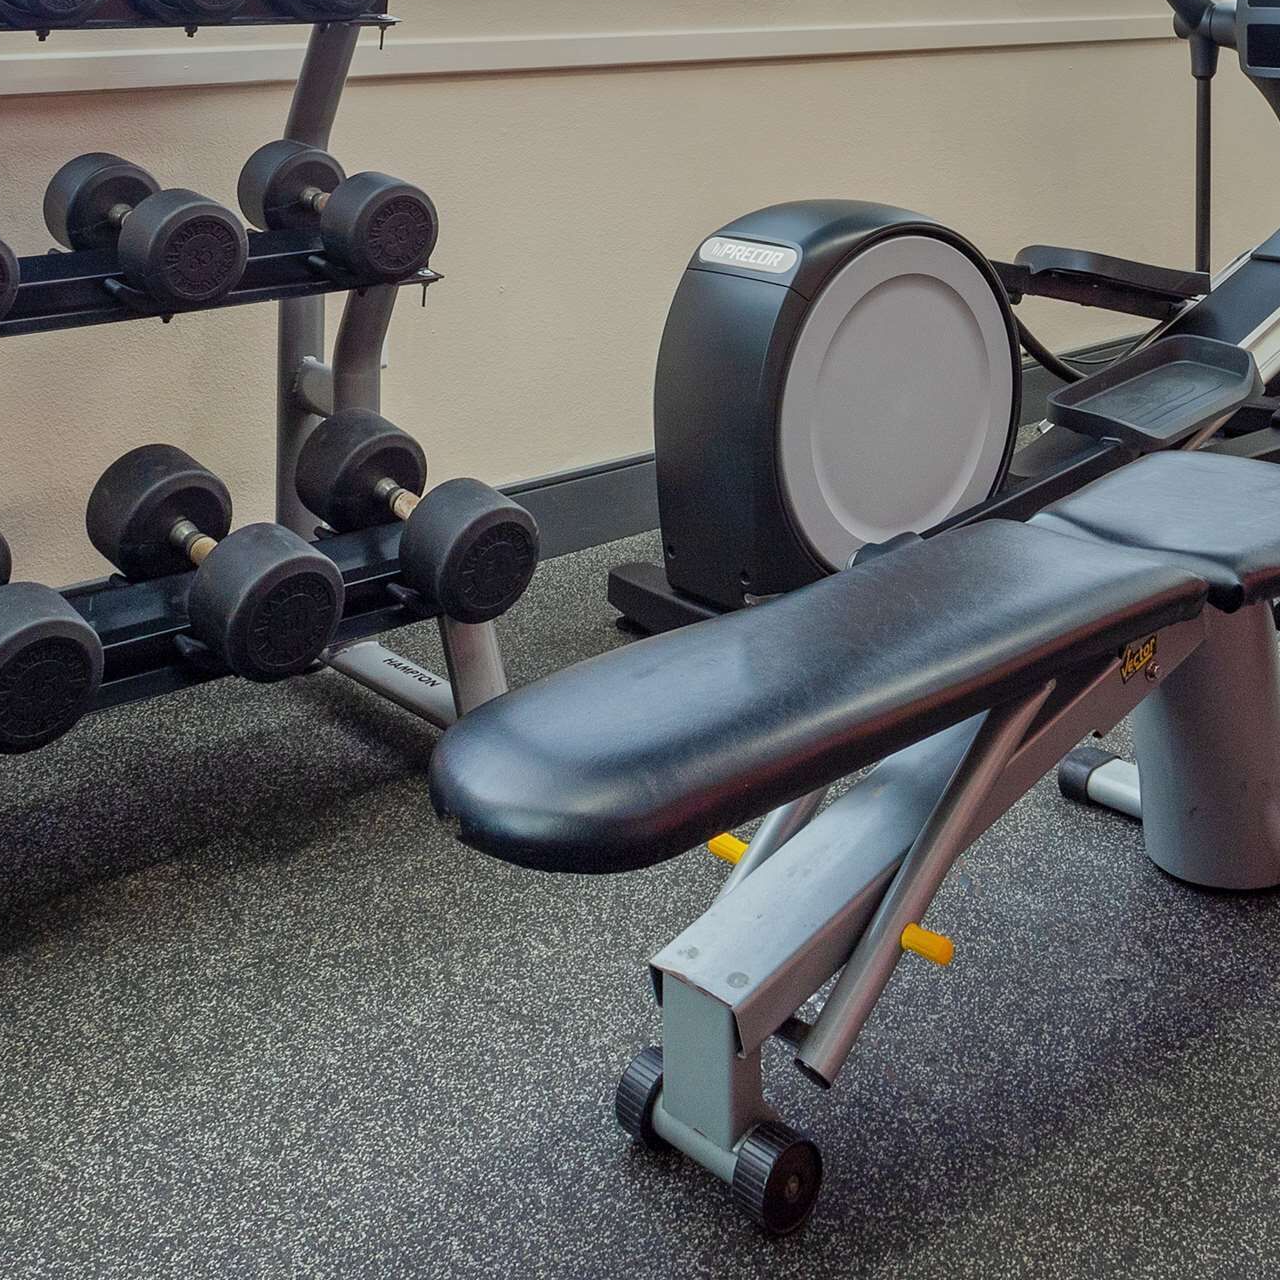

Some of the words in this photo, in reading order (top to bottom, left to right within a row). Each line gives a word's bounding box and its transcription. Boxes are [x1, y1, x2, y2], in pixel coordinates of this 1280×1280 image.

[721, 244, 784, 267] PRECOR
[383, 657, 442, 687] HAMPTON
[1121, 637, 1156, 678] Vector
